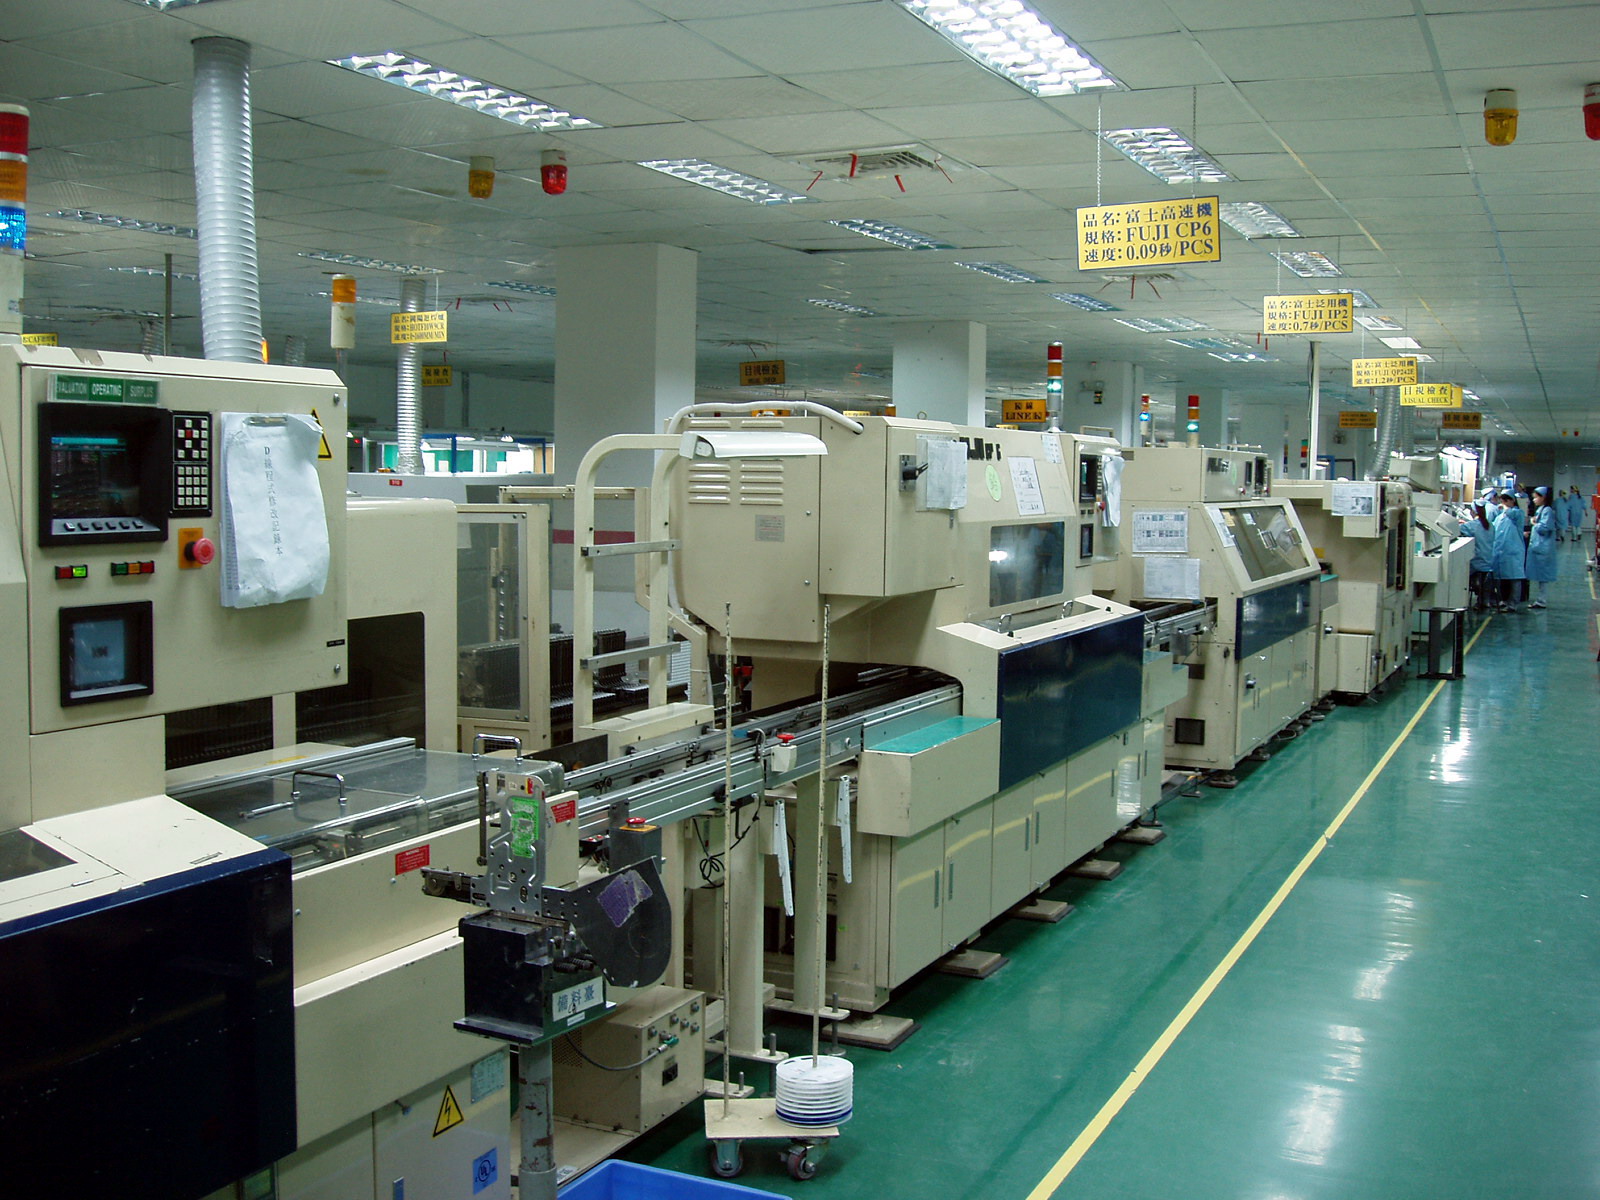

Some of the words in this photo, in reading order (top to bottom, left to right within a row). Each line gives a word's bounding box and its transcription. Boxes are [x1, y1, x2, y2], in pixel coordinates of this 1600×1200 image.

[1083, 202, 1212, 228] 品名:富士高速機
[1084, 223, 1170, 245] 規格:FUJI
[1175, 220, 1212, 239] CP6
[1084, 238, 1214, 263] 速度:0.09秒/PCS
[1268, 309, 1323, 321] 規格:FUJI
[1328, 309, 1348, 320] IP2
[1268, 320, 1348, 331] 速度:0.7秒/PCS
[91, 383, 122, 397] OPERATING
[1404, 386, 1448, 395] 目視檢查
[1006, 412, 1031, 420] LINE
